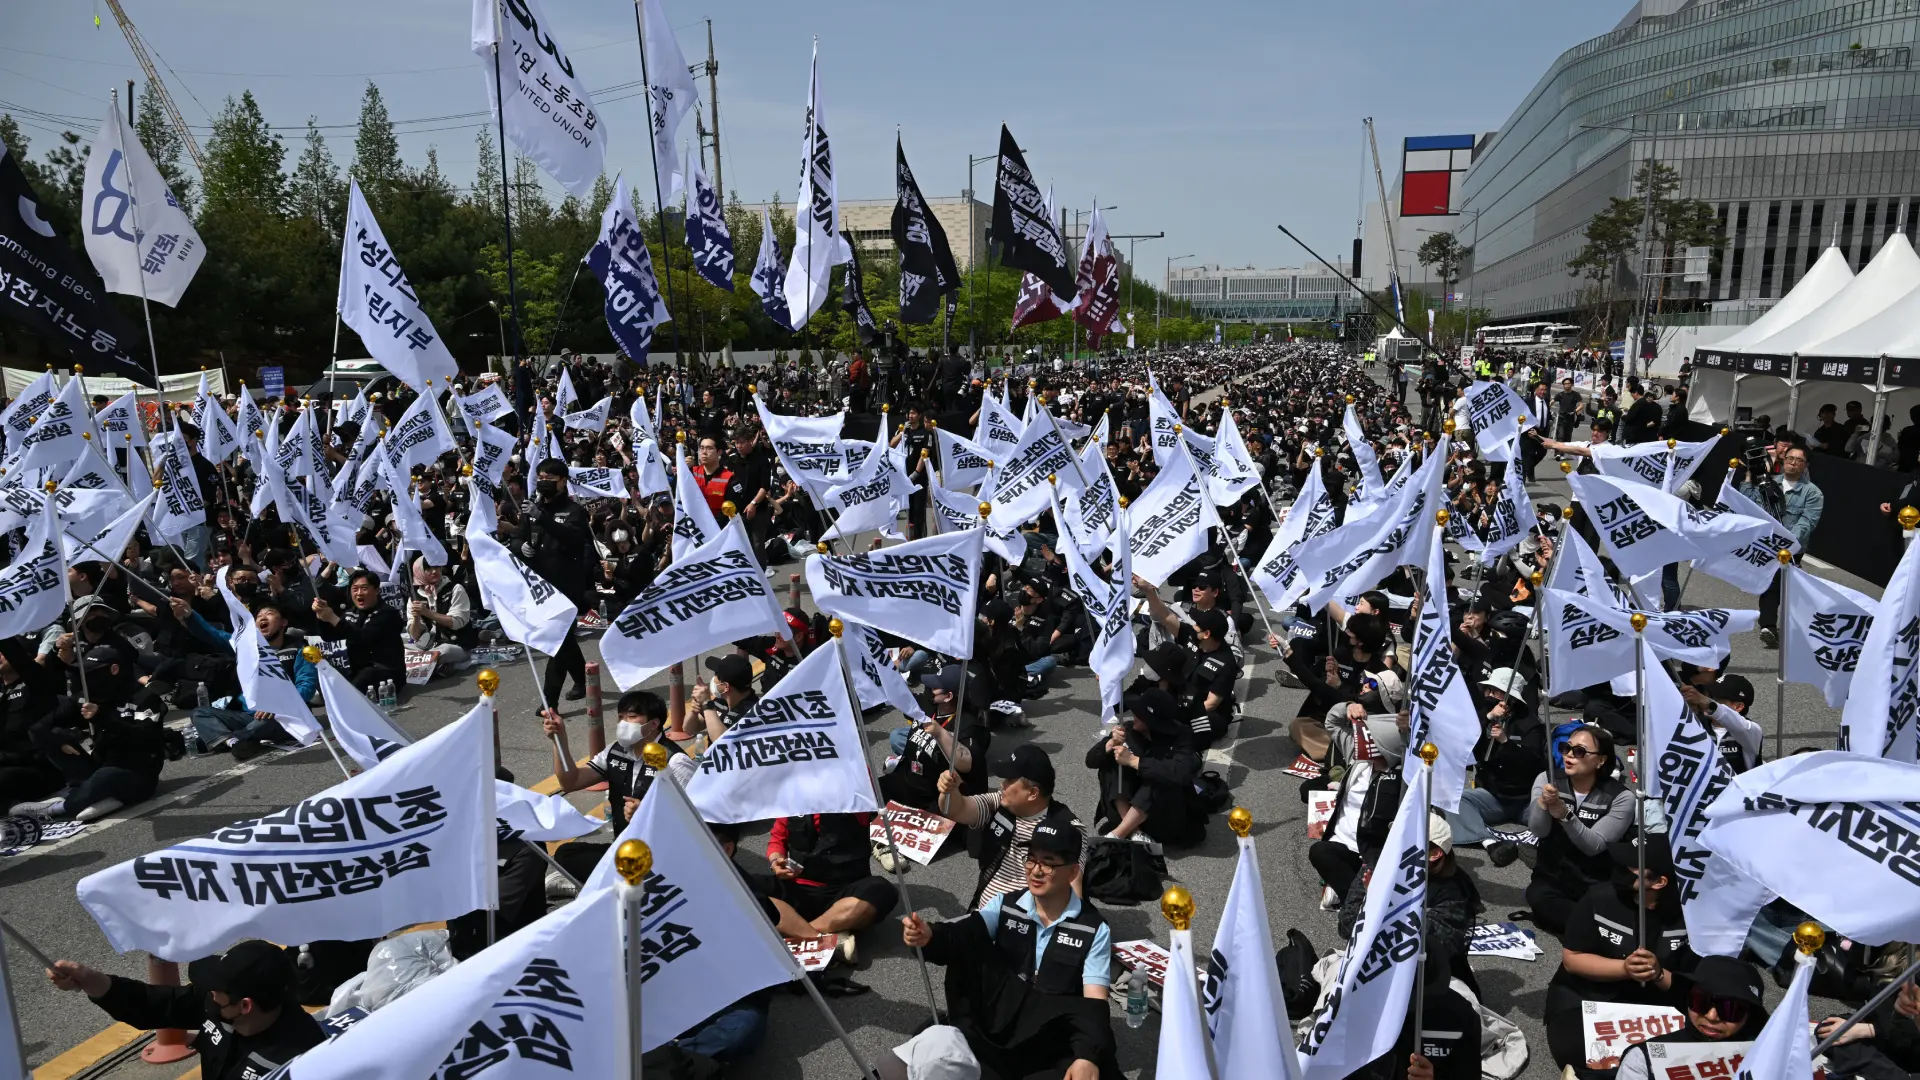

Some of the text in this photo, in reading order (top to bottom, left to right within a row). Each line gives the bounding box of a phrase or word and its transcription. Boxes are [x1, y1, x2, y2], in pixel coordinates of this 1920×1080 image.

[536, 72, 598, 131] 노동조합
[552, 111, 592, 148] UNION
[1837, 363, 1849, 377] 본부
[1489, 398, 1512, 424] 지부
[1578, 812, 1599, 821] SELU
[1004, 918, 1030, 936] 투쟁
[1057, 935, 1084, 949] SELU
[202, 1019, 224, 1046] 투쟁
